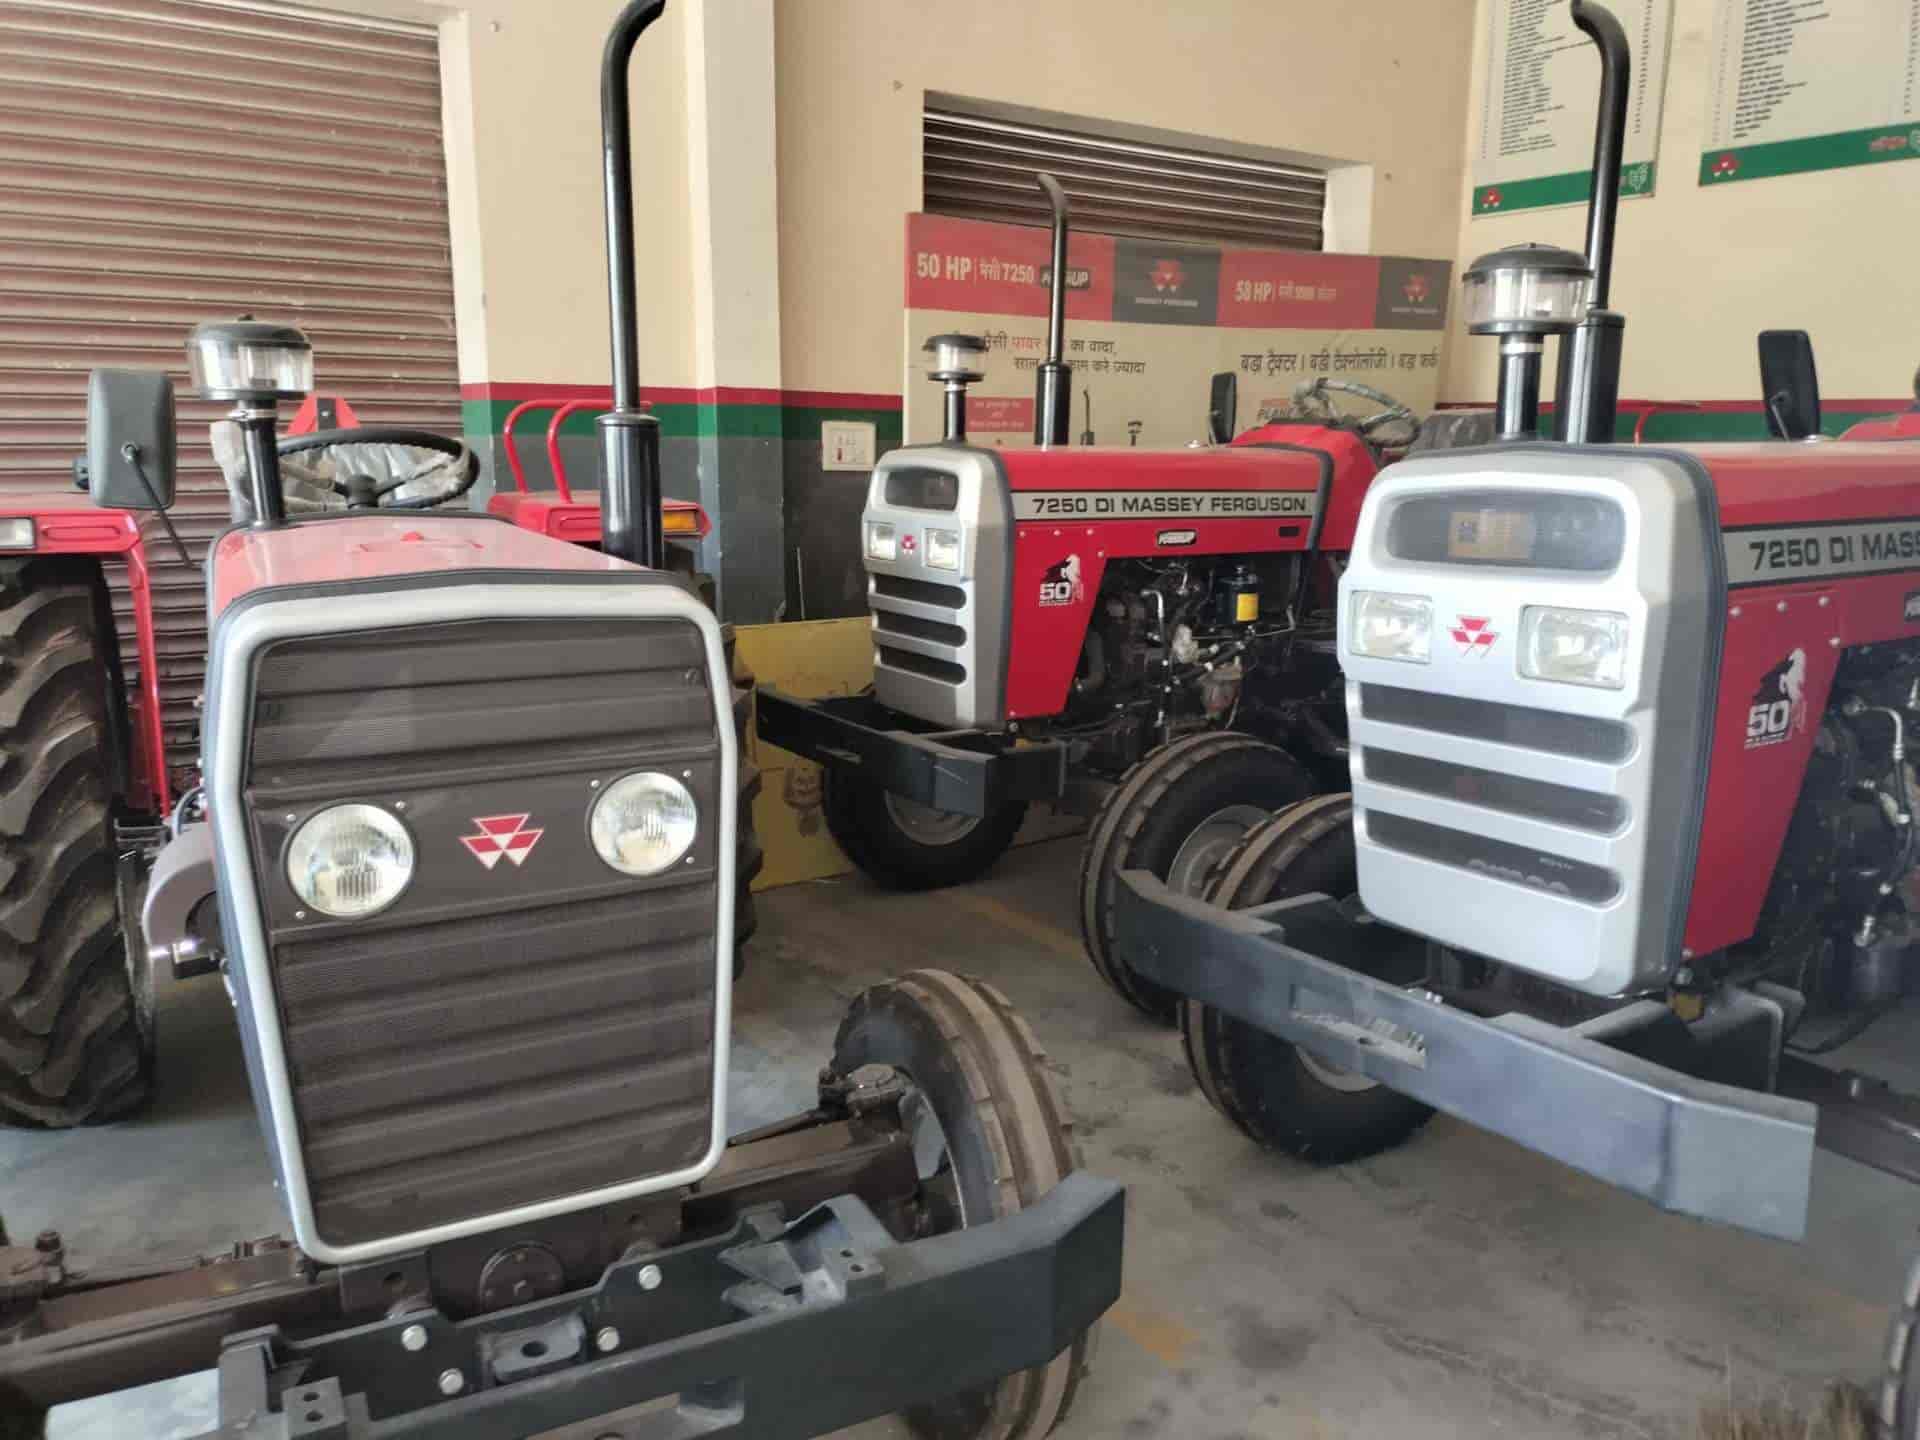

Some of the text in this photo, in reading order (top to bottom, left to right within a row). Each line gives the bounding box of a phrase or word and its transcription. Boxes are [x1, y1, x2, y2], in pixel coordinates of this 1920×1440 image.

[916, 252, 940, 279] 50
[945, 255, 971, 281] HP
[1001, 263, 1034, 284] 7250
[1032, 496, 1306, 513] 7250 DI MASSEY FERGUSON
[1749, 538, 1821, 571] 7250
[1828, 536, 1853, 564] DI
[1039, 582, 1072, 601] 50
[1747, 699, 1791, 737] 50
